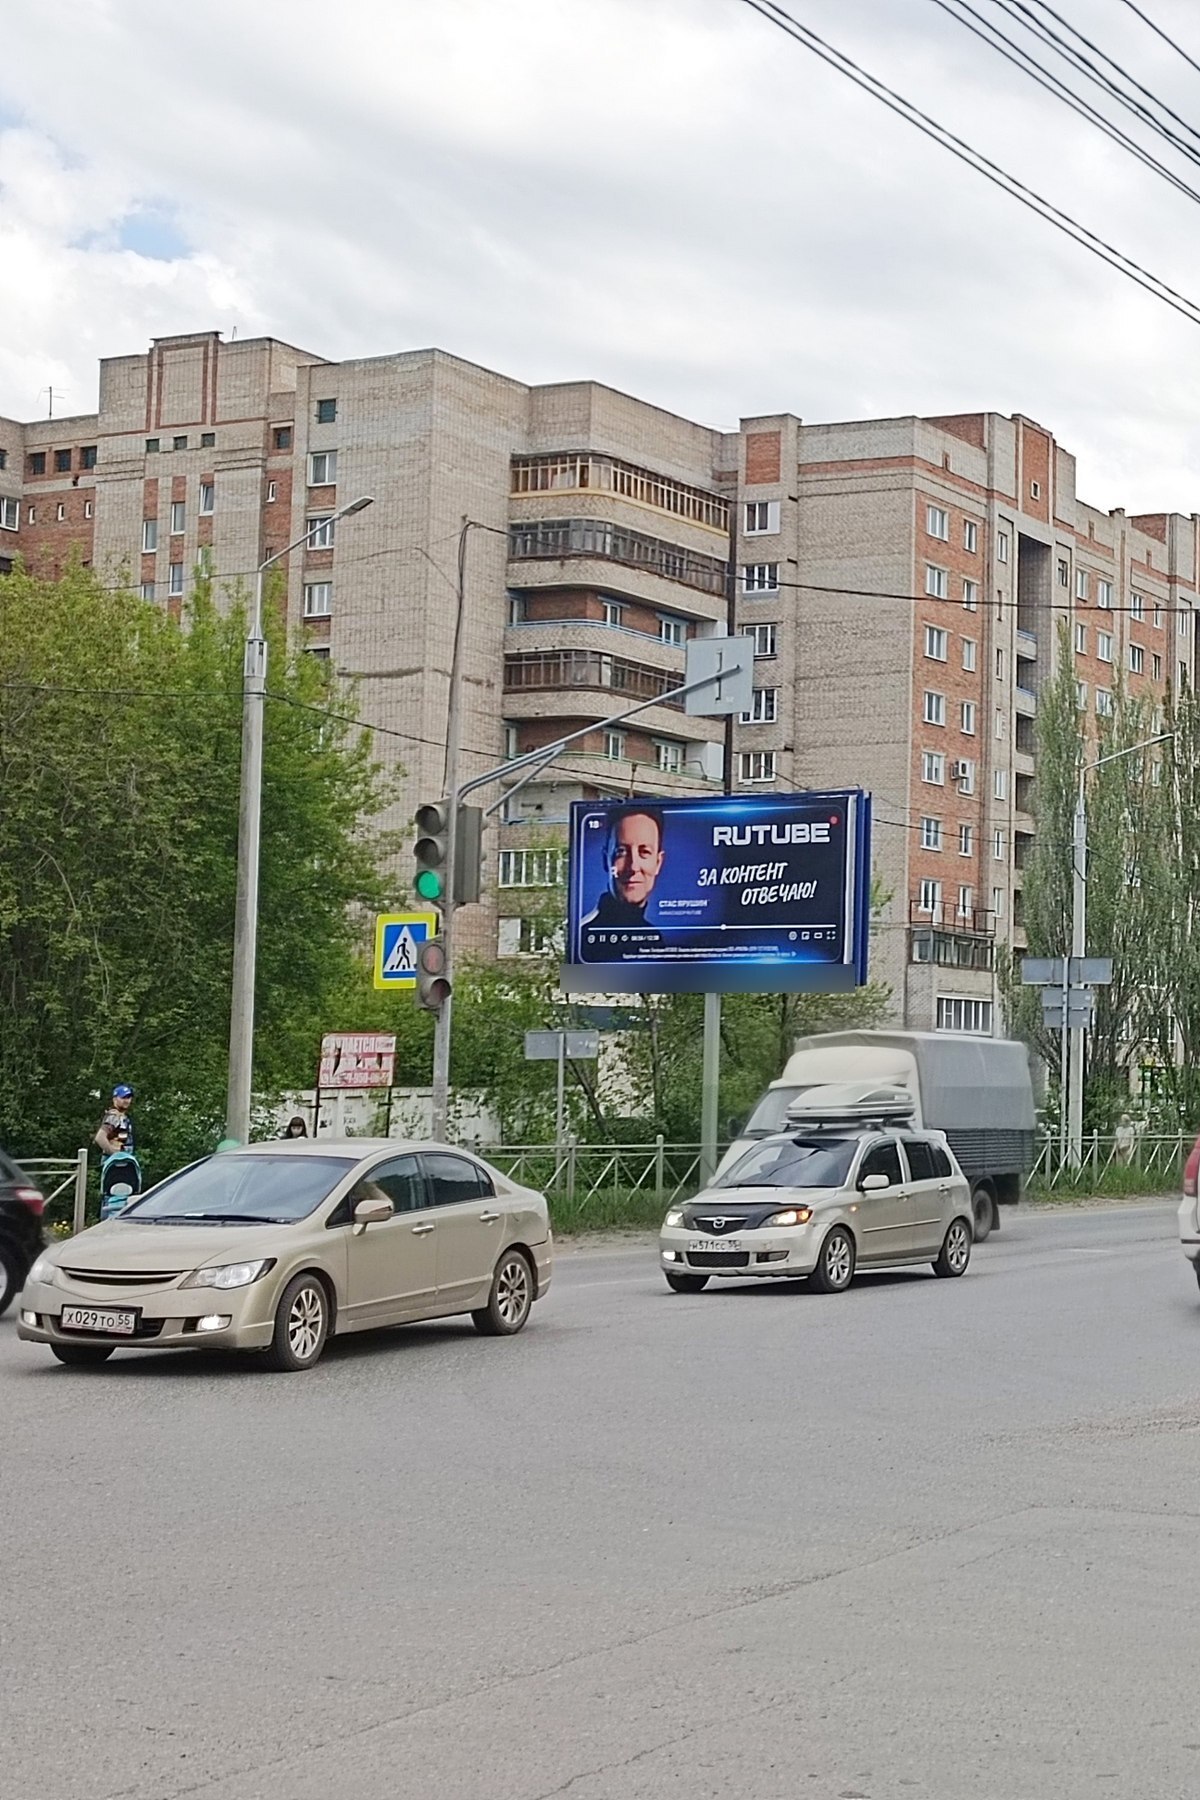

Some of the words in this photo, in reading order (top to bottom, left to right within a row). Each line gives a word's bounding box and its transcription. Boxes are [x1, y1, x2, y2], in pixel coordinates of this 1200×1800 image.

[713, 823, 831, 846] RUTUBE
[697, 868, 718, 887] ЗА
[719, 862, 789, 885] КОНТЕНТ
[740, 880, 818, 906] ОТВЕЧАЮ!
[67, 1310, 115, 1328] Х029ТО
[118, 1314, 130, 1326] 55
